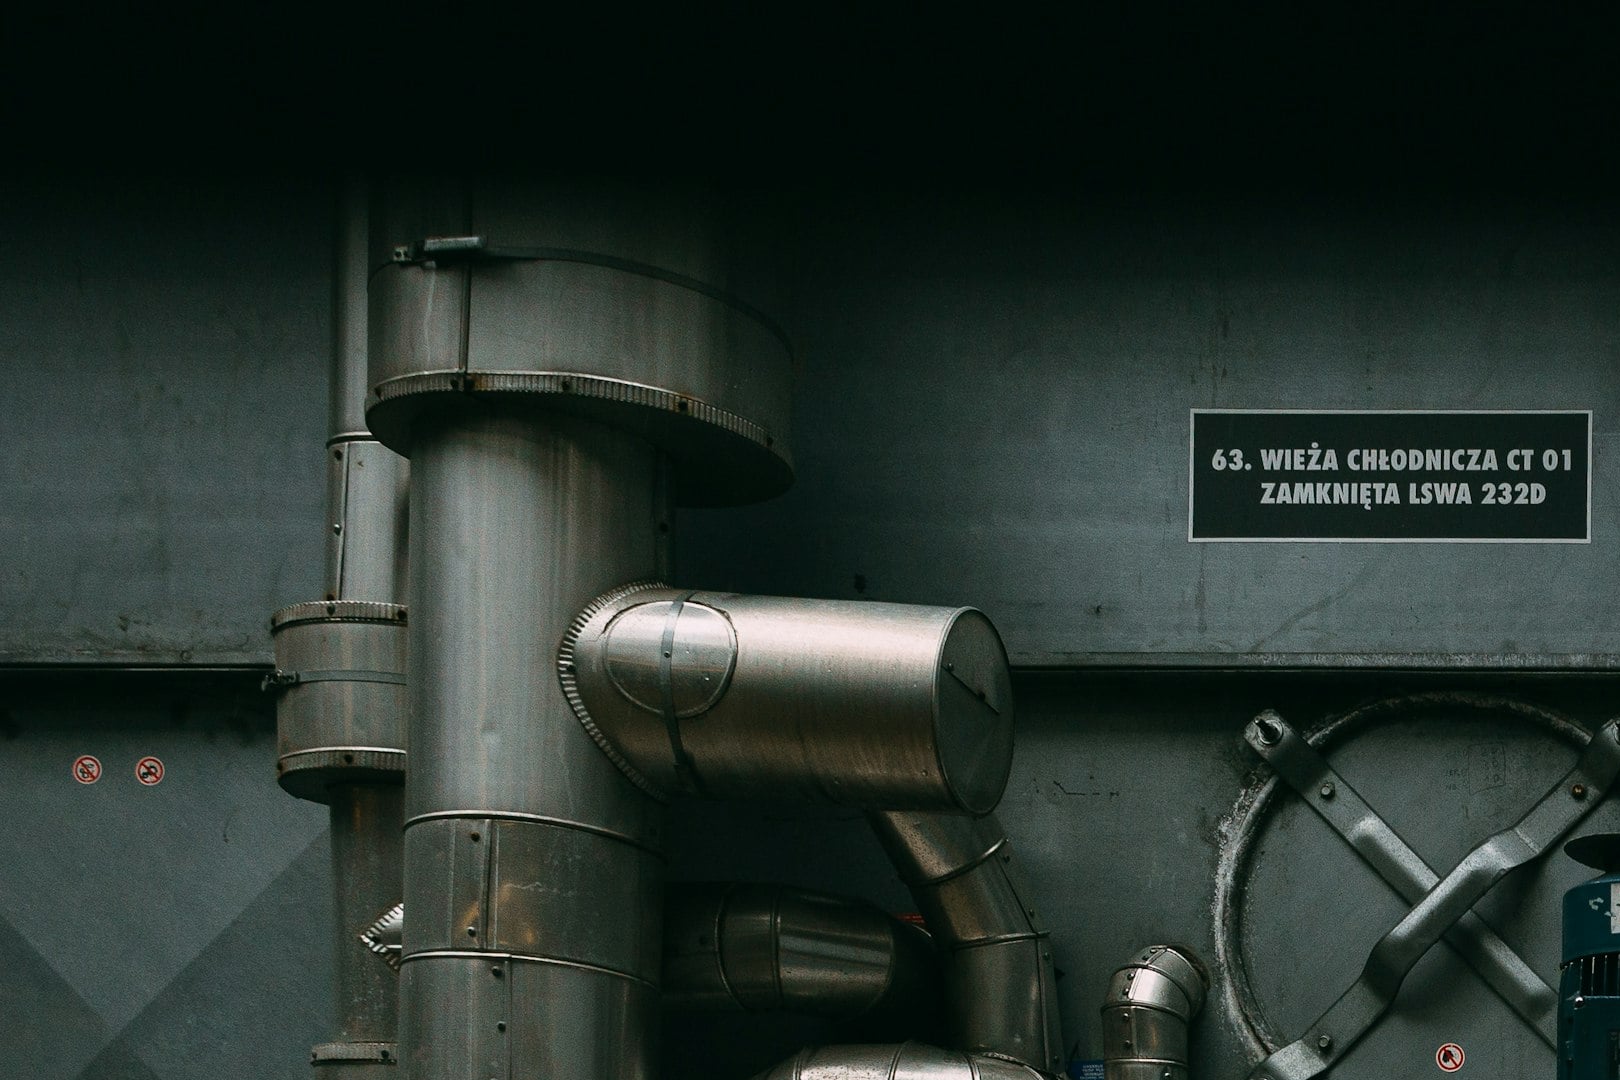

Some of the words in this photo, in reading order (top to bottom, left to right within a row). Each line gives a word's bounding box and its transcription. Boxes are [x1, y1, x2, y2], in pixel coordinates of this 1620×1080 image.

[1211, 448, 1252, 471] 63.
[1259, 441, 1339, 471] WIEŻA
[1346, 448, 1499, 471] CHŁODNICZA
[1506, 448, 1535, 471] CT
[1542, 448, 1572, 472] 01
[1259, 482, 1401, 511] ZAMKNIĘTA
[1408, 482, 1473, 505] LSWA
[1480, 482, 1547, 505] 232D
